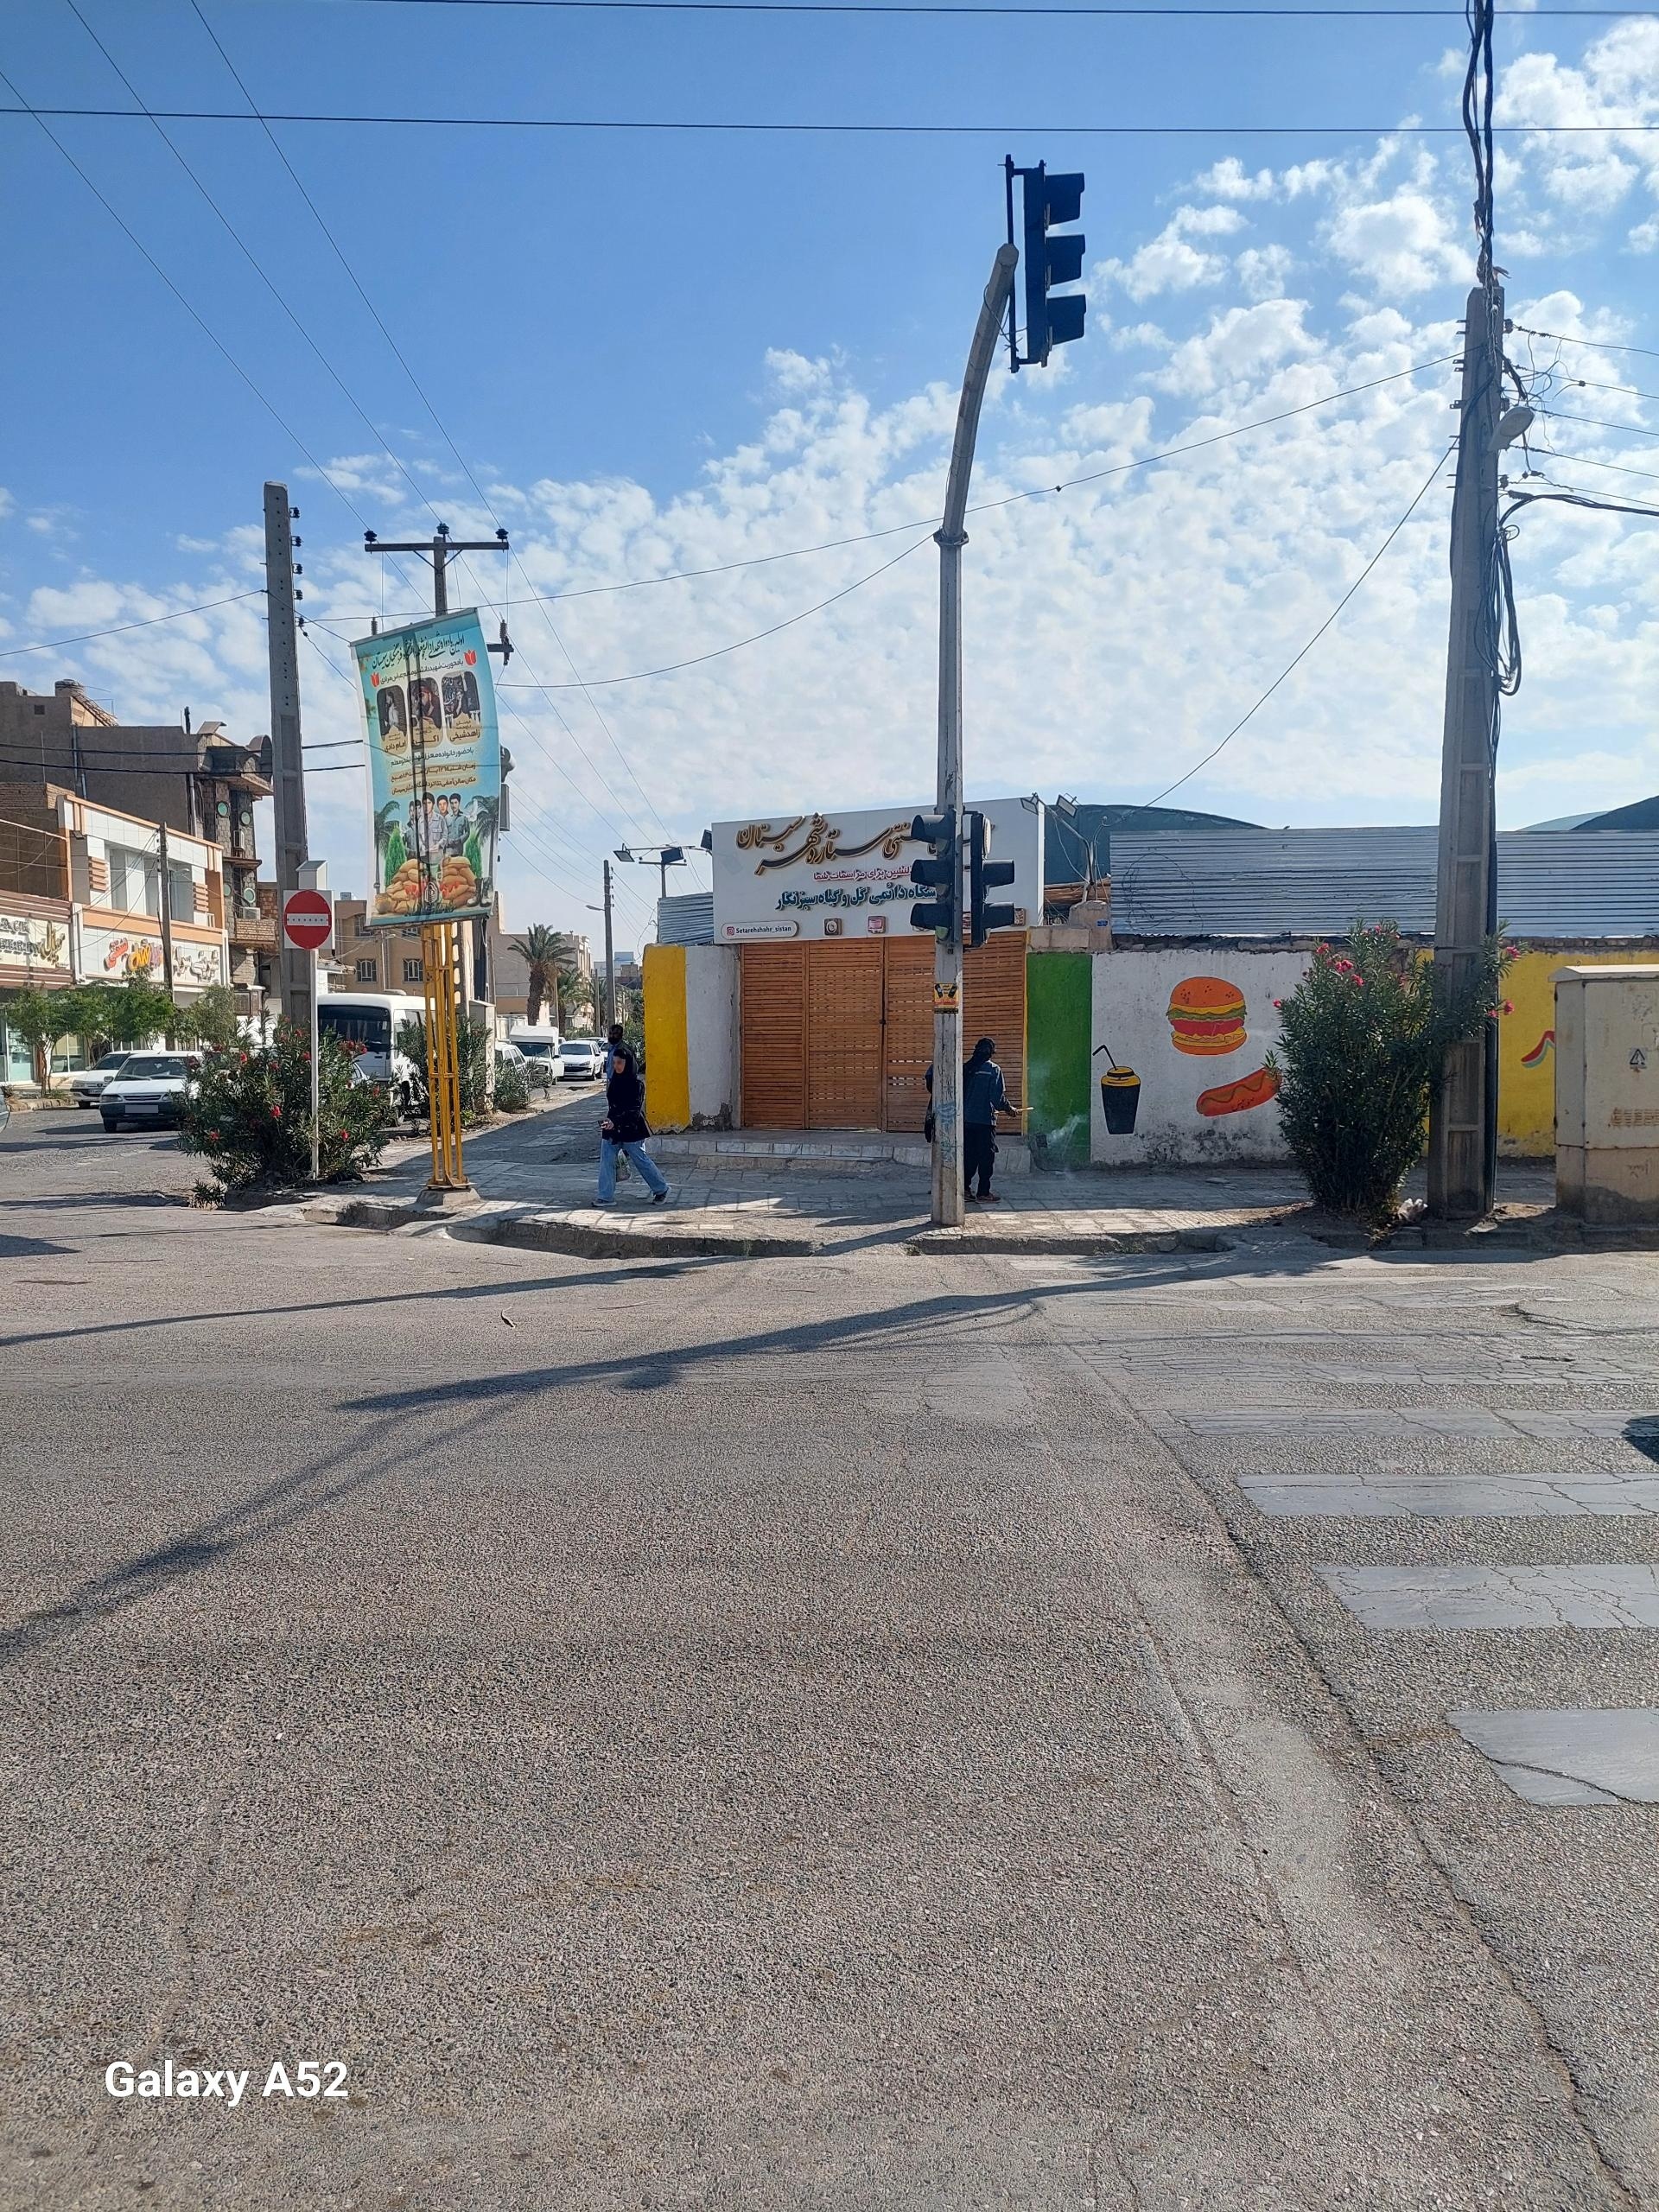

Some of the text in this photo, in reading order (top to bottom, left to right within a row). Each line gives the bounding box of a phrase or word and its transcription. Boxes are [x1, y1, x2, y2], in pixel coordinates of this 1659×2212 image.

[736, 815, 805, 852] سیستان
[753, 812, 828, 875] شهر
[813, 871, 830, 882] شما
[830, 868, 865, 882] مراسمات
[867, 868, 884, 880] برای
[817, 888, 843, 906] گیاه
[850, 887, 870, 906] گل
[869, 882, 906, 905] دائمی
[735, 925, 791, 934] Setarehshahr_sistan
